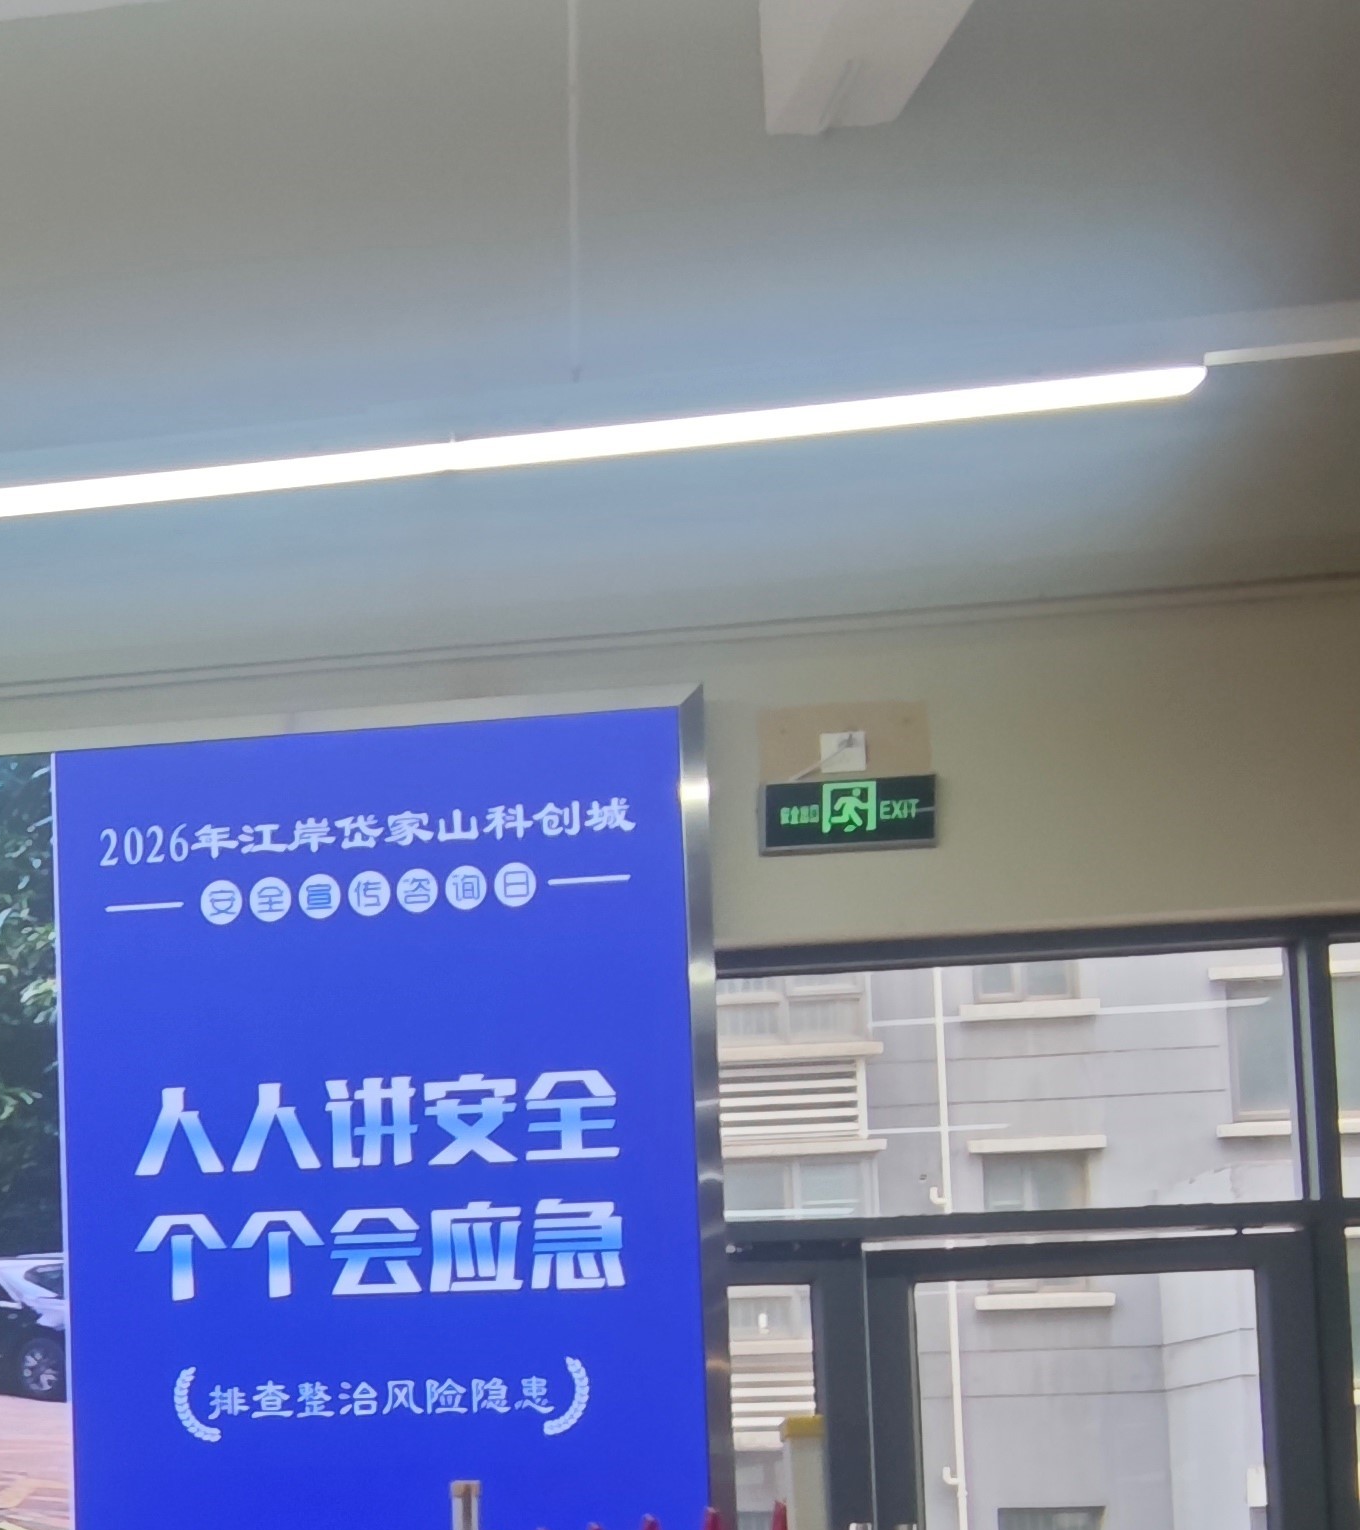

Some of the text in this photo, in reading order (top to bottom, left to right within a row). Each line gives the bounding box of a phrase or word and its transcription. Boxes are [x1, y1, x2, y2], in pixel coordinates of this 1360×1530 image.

[100, 797, 636, 866] 2026年江岸岱家山科创城
[880, 798, 919, 820] EXIT
[206, 866, 532, 920] 安全宣传咨询日
[136, 1070, 620, 1176] 人人讲安全
[136, 1199, 626, 1301] 个个会应急
[209, 1376, 554, 1419] 排查整治风险隐患
